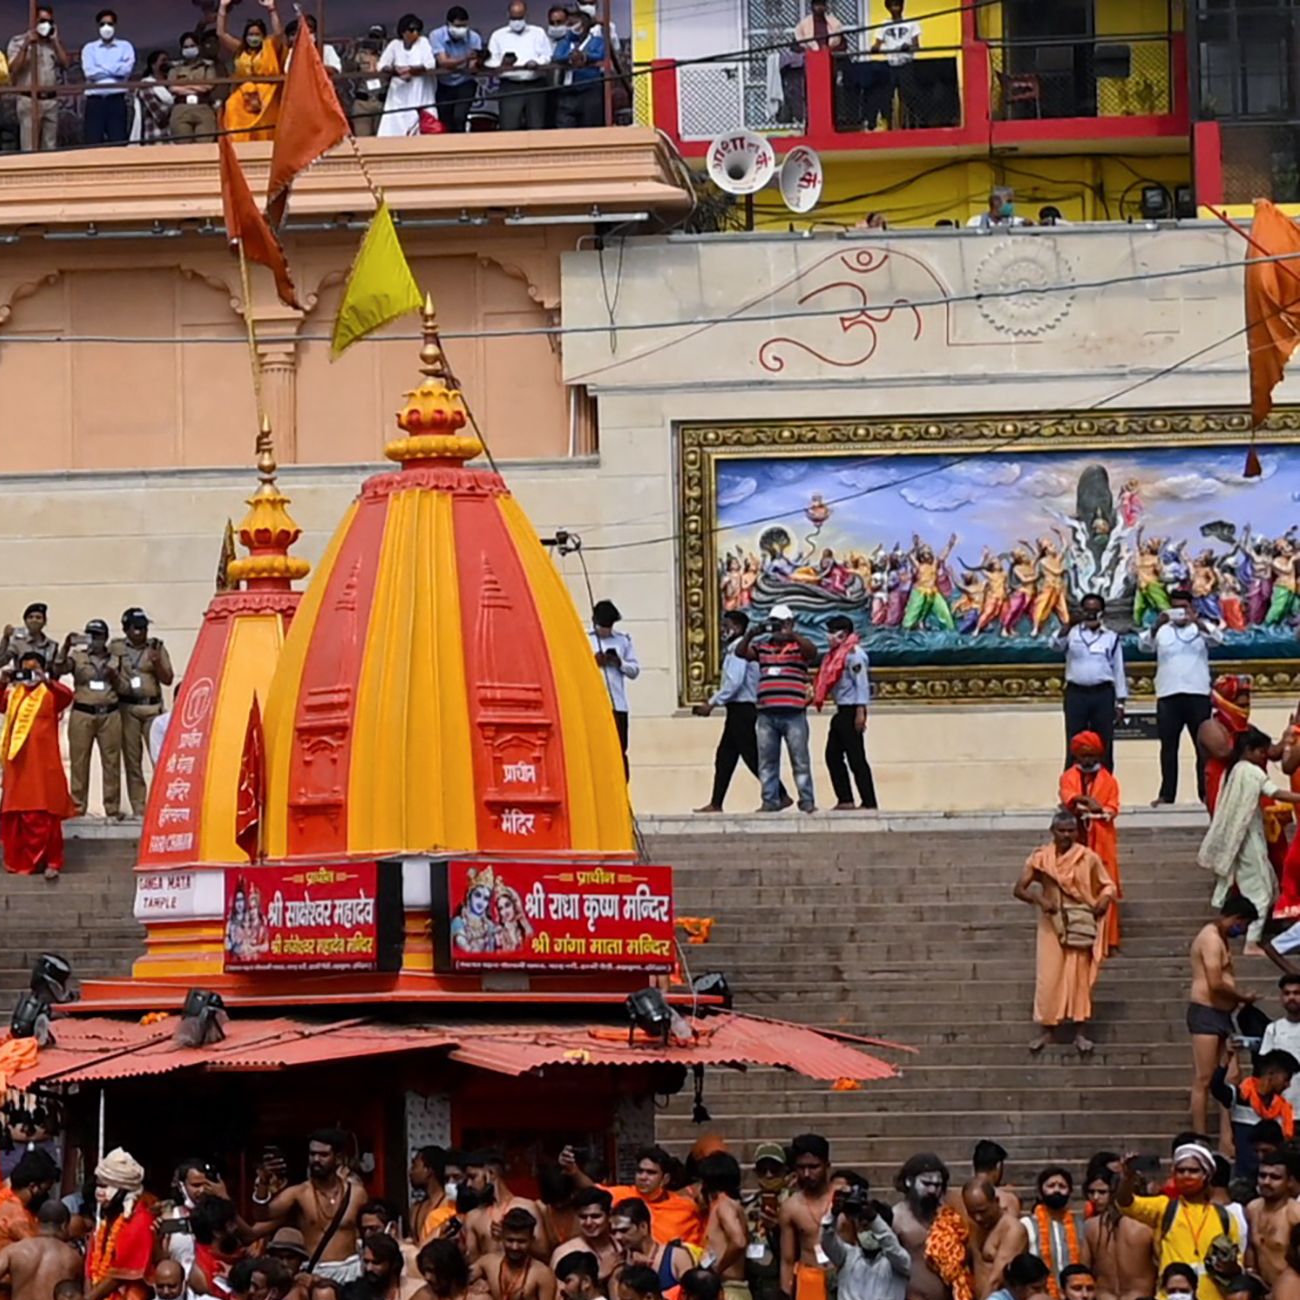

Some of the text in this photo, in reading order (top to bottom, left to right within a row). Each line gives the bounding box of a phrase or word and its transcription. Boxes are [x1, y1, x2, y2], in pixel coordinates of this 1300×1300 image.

[502, 760, 536, 783] प्राचीन
[501, 808, 536, 836] मंदिर
[576, 867, 615, 886] प्राचीन
[268, 890, 283, 927] श्री
[333, 888, 375, 928] महादेव
[525, 882, 669, 932] श्री राधा कृष्ण मन्दिर
[531, 931, 670, 956] श्री गंगा माता मन्दिर
